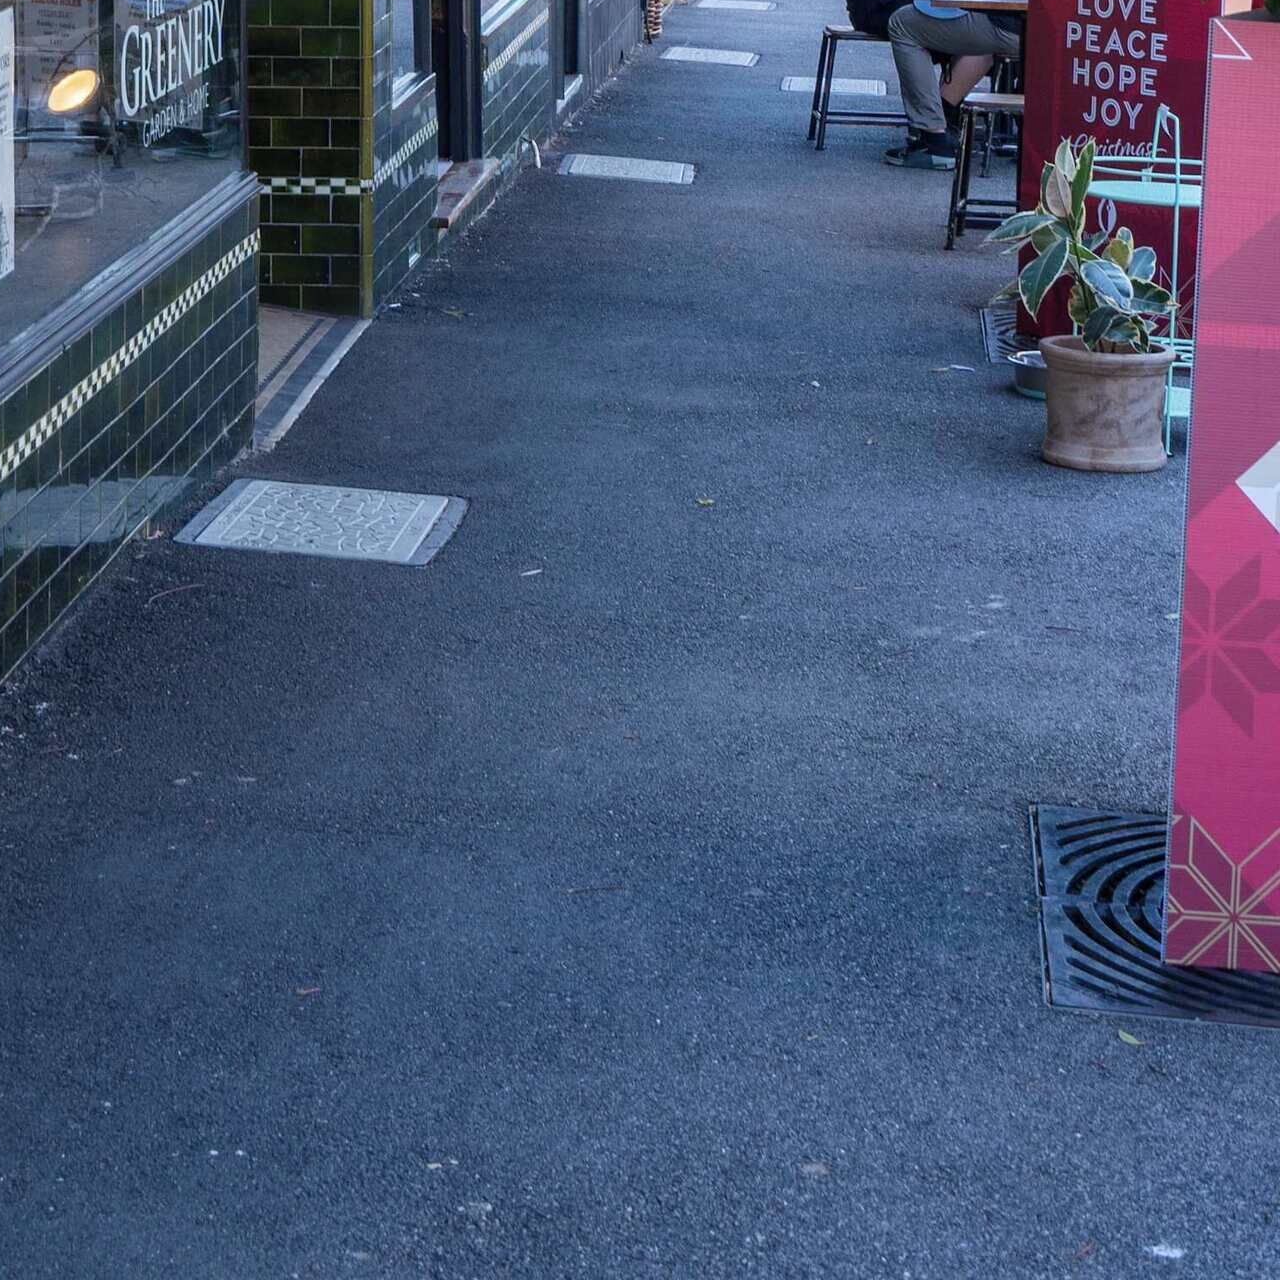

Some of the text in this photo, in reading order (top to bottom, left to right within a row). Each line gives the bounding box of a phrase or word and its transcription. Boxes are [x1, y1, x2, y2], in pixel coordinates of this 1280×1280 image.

[1066, 20, 1169, 62] PEACE
[1072, 57, 1158, 97] HOPE
[141, 81, 210, 149] GARDEN & HOME
[1082, 96, 1144, 130] JOY
[1070, 133, 1167, 158] Cristmas
